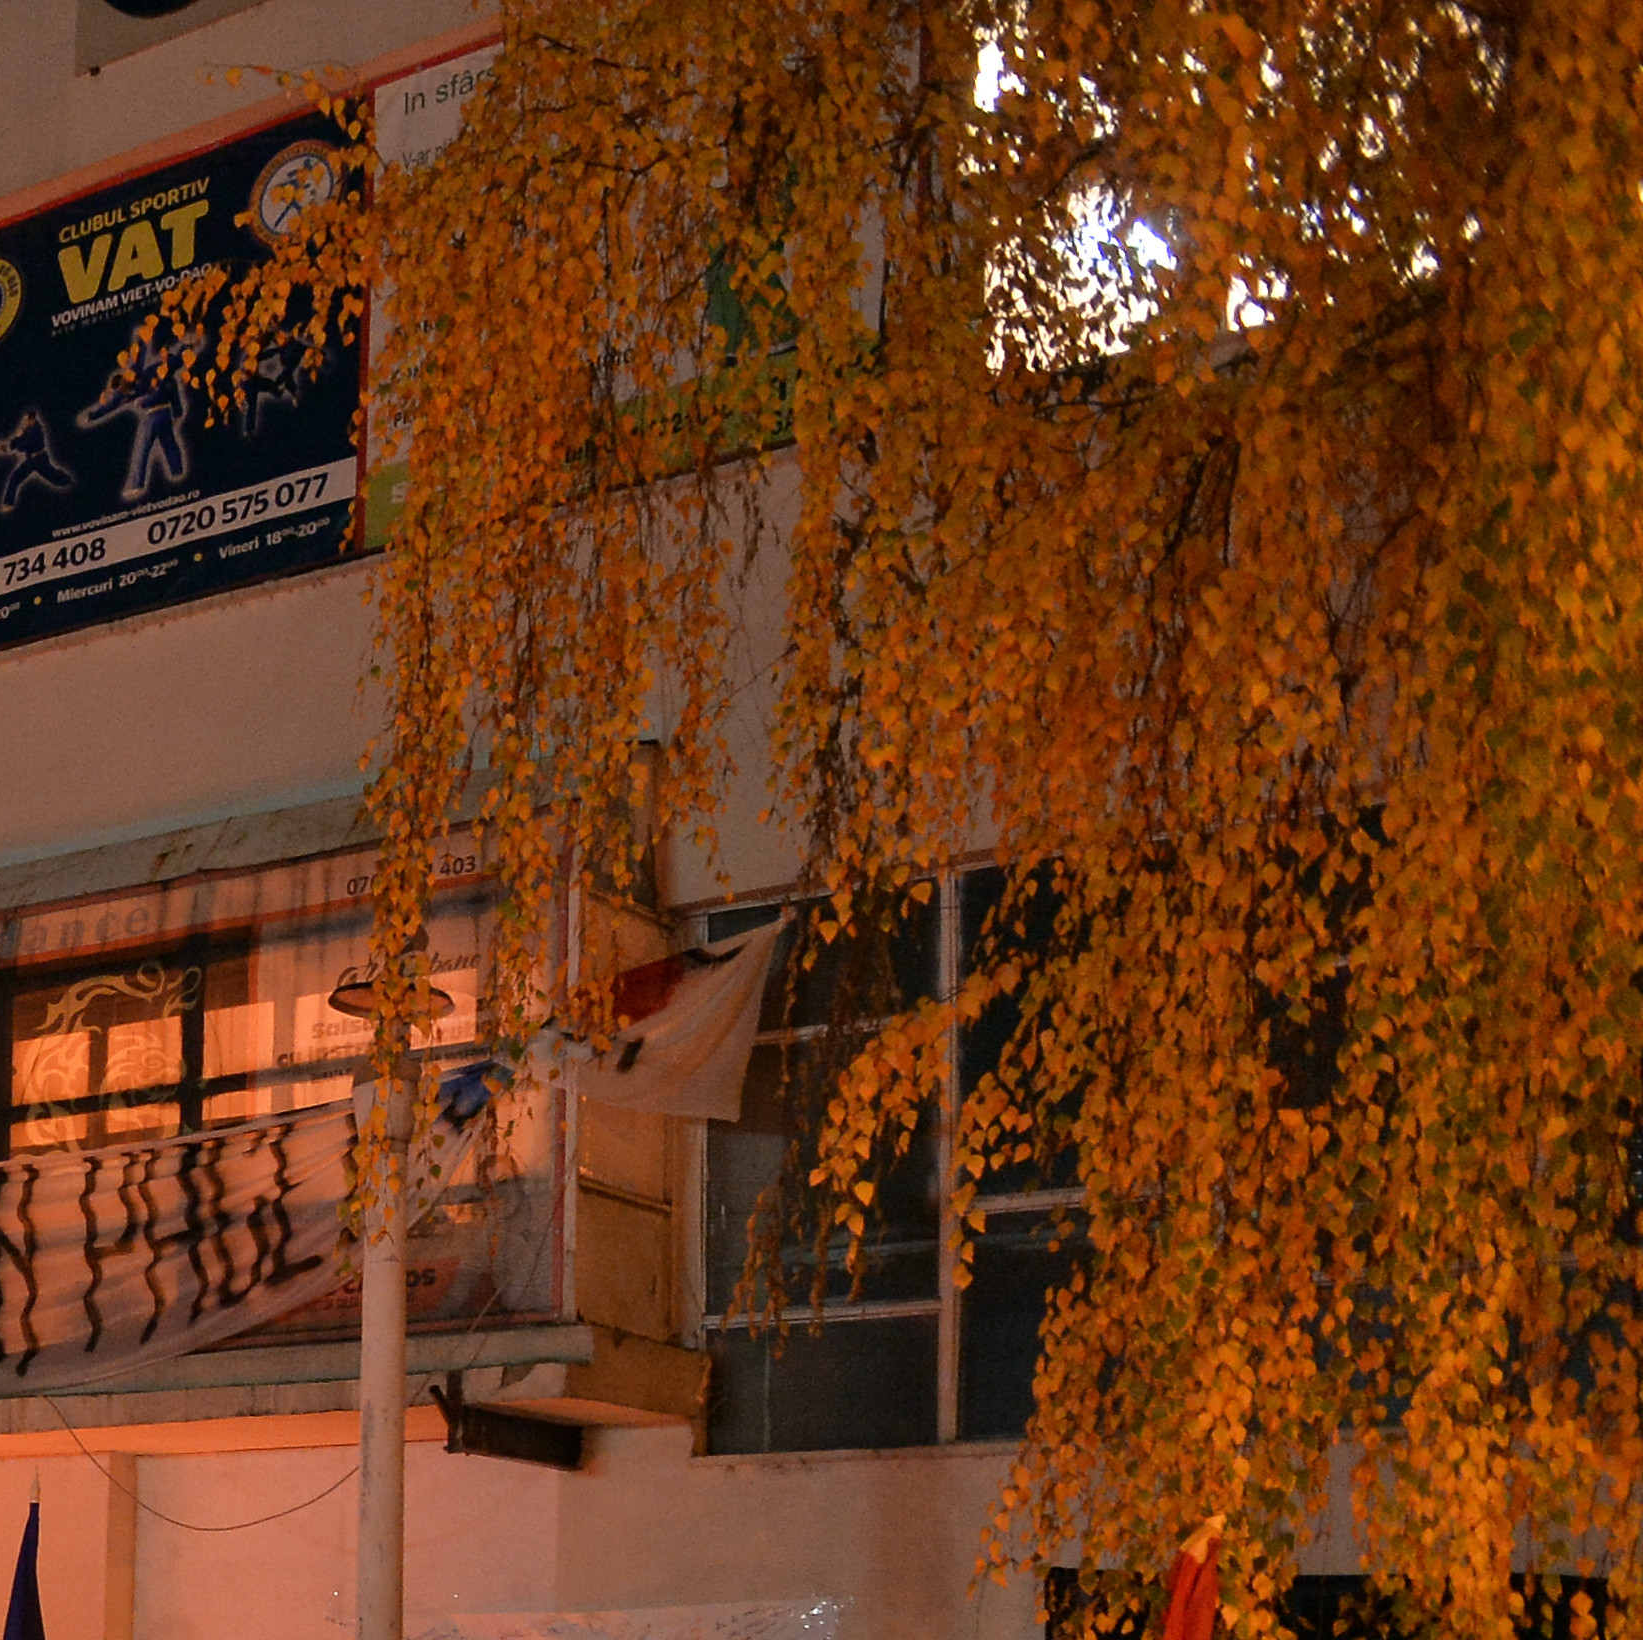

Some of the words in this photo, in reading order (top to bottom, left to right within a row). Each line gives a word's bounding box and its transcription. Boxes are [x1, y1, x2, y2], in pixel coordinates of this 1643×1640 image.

[404, 90, 426, 115] In
[58, 207, 128, 244] CLUBUL
[130, 176, 211, 220] SPORTIV
[57, 199, 210, 304] VAT
[51, 295, 118, 328] VOVINAM
[120, 263, 212, 305] VIET-VO-DAO
[3, 553, 46, 587] 734
[52, 537, 106, 572] 408
[147, 504, 215, 546] 0720
[221, 490, 269, 526] 575
[274, 472, 329, 509] 077
[57, 577, 113, 603] Miercuri
[219, 536, 260, 560] Vineri
[440, 856, 477, 877] 403
